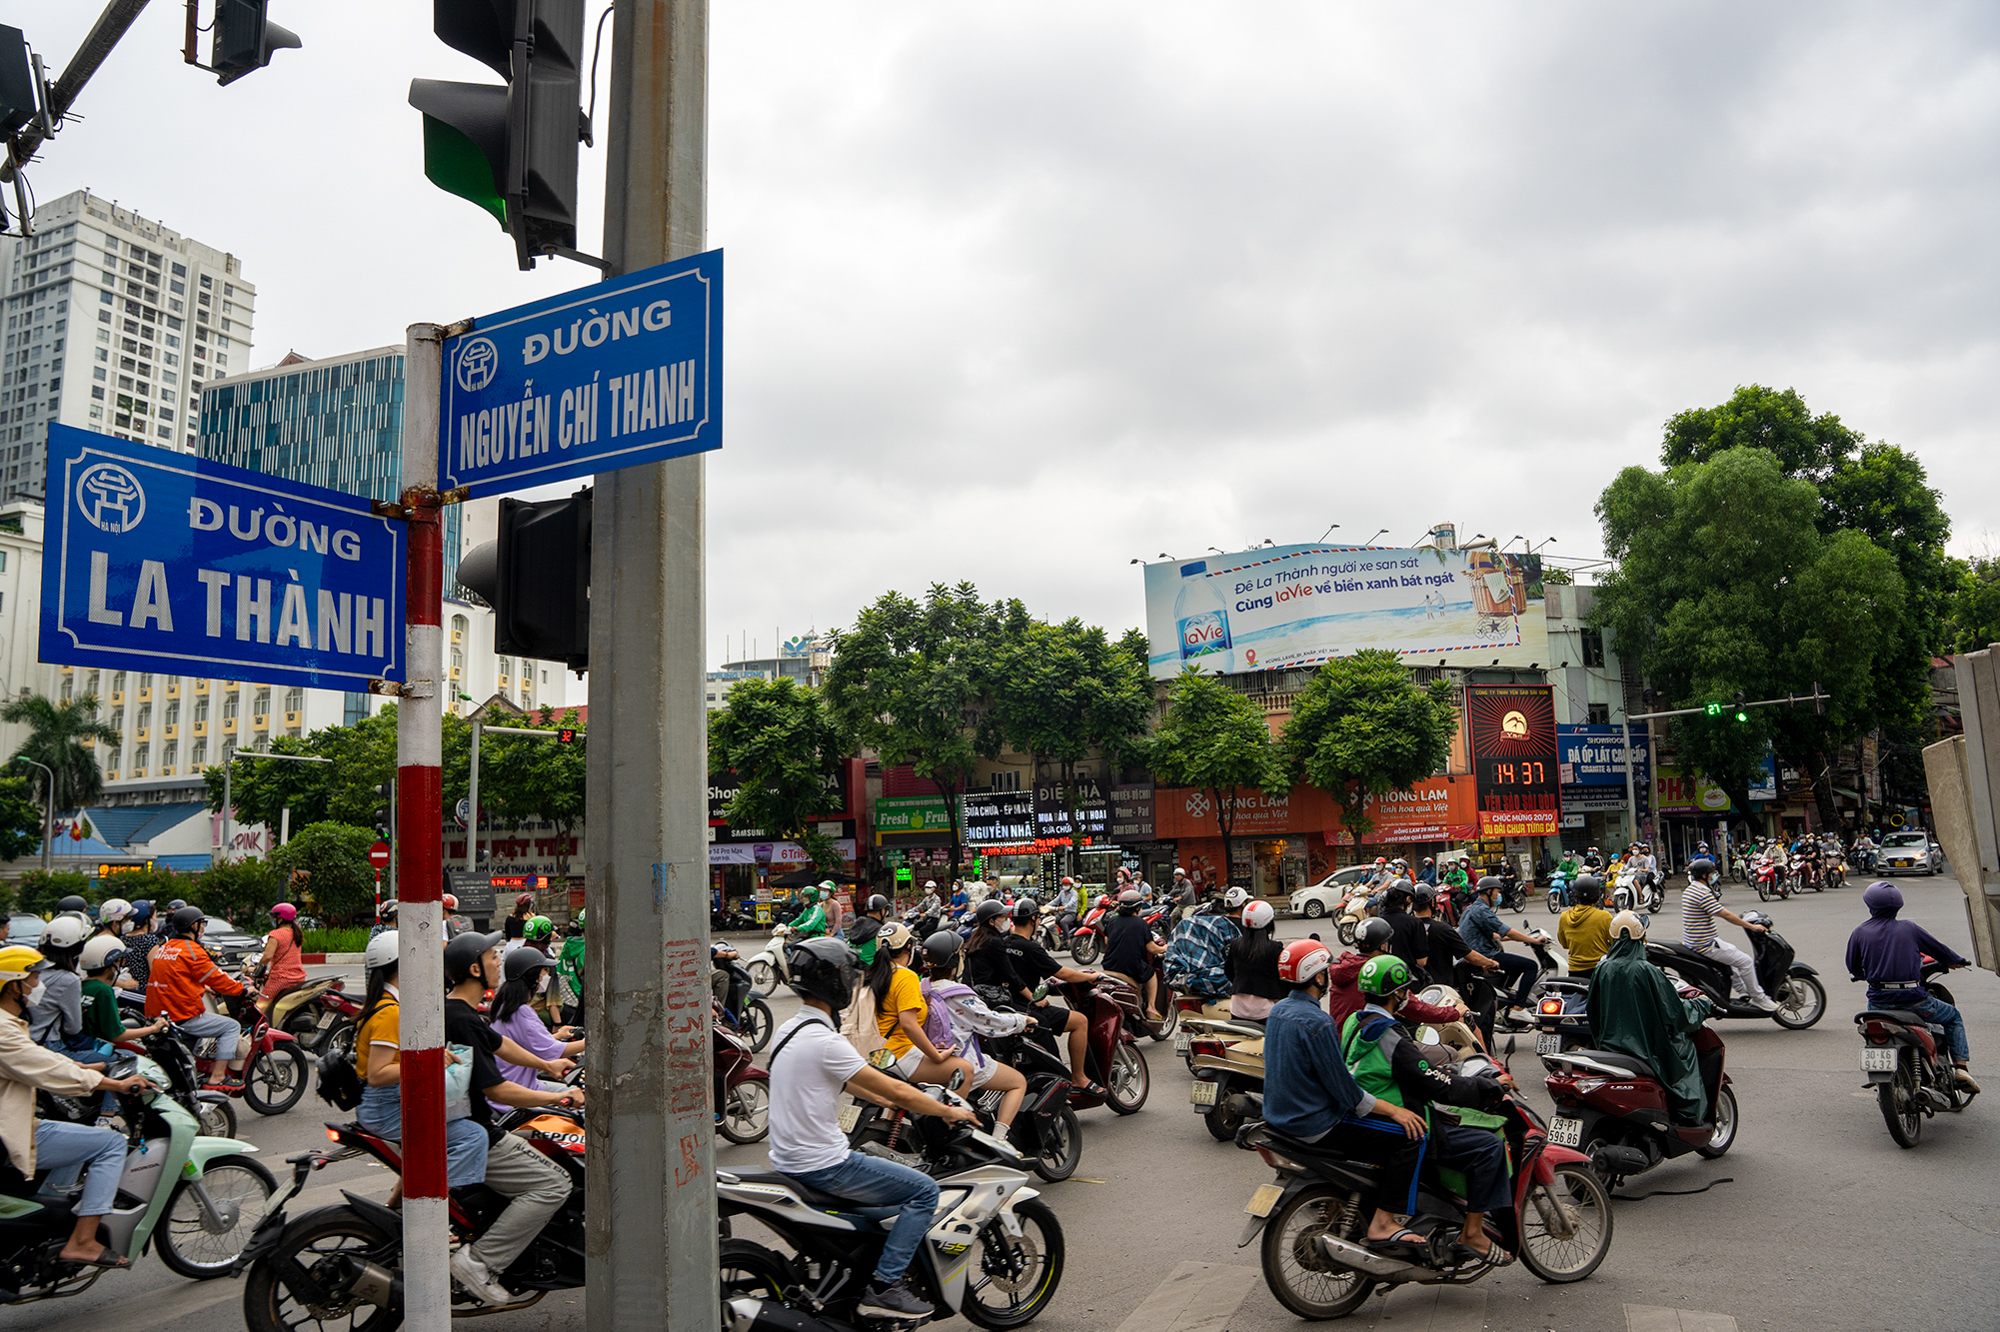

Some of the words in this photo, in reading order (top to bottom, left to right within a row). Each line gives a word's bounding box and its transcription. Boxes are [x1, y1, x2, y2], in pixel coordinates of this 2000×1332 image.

[522, 300, 671, 366] ĐƯỜNG
[460, 378, 551, 471] NGUYỄN
[558, 370, 600, 450] CHÍ
[609, 358, 695, 438] THANH
[187, 496, 361, 561] ĐƯỜNG
[1234, 580, 1253, 595] Đê
[1257, 577, 1272, 590] La
[1275, 564, 1318, 584] Thành
[1321, 560, 1356, 577] người
[1360, 562, 1373, 572] xe
[1376, 560, 1398, 570] san
[1400, 556, 1418, 568] sát
[1235, 595, 1273, 613] Cùng
[1275, 582, 1312, 602] laVie
[1315, 580, 1331, 594] về
[1366, 576, 1398, 590] xanh
[1400, 574, 1422, 587] bát
[1424, 572, 1454, 587] ngát
[88, 550, 174, 632] LA
[198, 568, 385, 658] THÀNH
[1184, 624, 1224, 646] laVie
[1708, 703, 1721, 715] 27
[561, 730, 572, 742] 32
[1594, 746, 1610, 763] LÁT
[1040, 782, 1065, 804] ĐIỆ
[1080, 780, 1100, 798] HÀ
[1420, 789, 1448, 800] LAM
[1260, 796, 1288, 808] LAM
[1503, 791, 1520, 811] SÀO
[1115, 807, 1132, 818] Phone
[1138, 806, 1149, 816] Pad
[1272, 809, 1288, 820] Việt
[1433, 803, 1448, 813] Việt
[880, 812, 908, 825] Fresh
[1492, 813, 1512, 822] CHÚC
[969, 820, 1009, 839] NGUYỄN
[1507, 823, 1526, 834] CHƯA
[234, 832, 263, 852] PINK
[781, 850, 787, 859] 6
[511, 865, 537, 874] THANH
[162, 951, 179, 960] Food
[1865, 1050, 1891, 1059] 30-K6
[1865, 1060, 1892, 1069] 9432
[1554, 1119, 1577, 1132] 29-P1
[1549, 1130, 1578, 1145] 596.86
[513, 1142, 552, 1167] ALONE
[938, 1240, 968, 1251] 155
